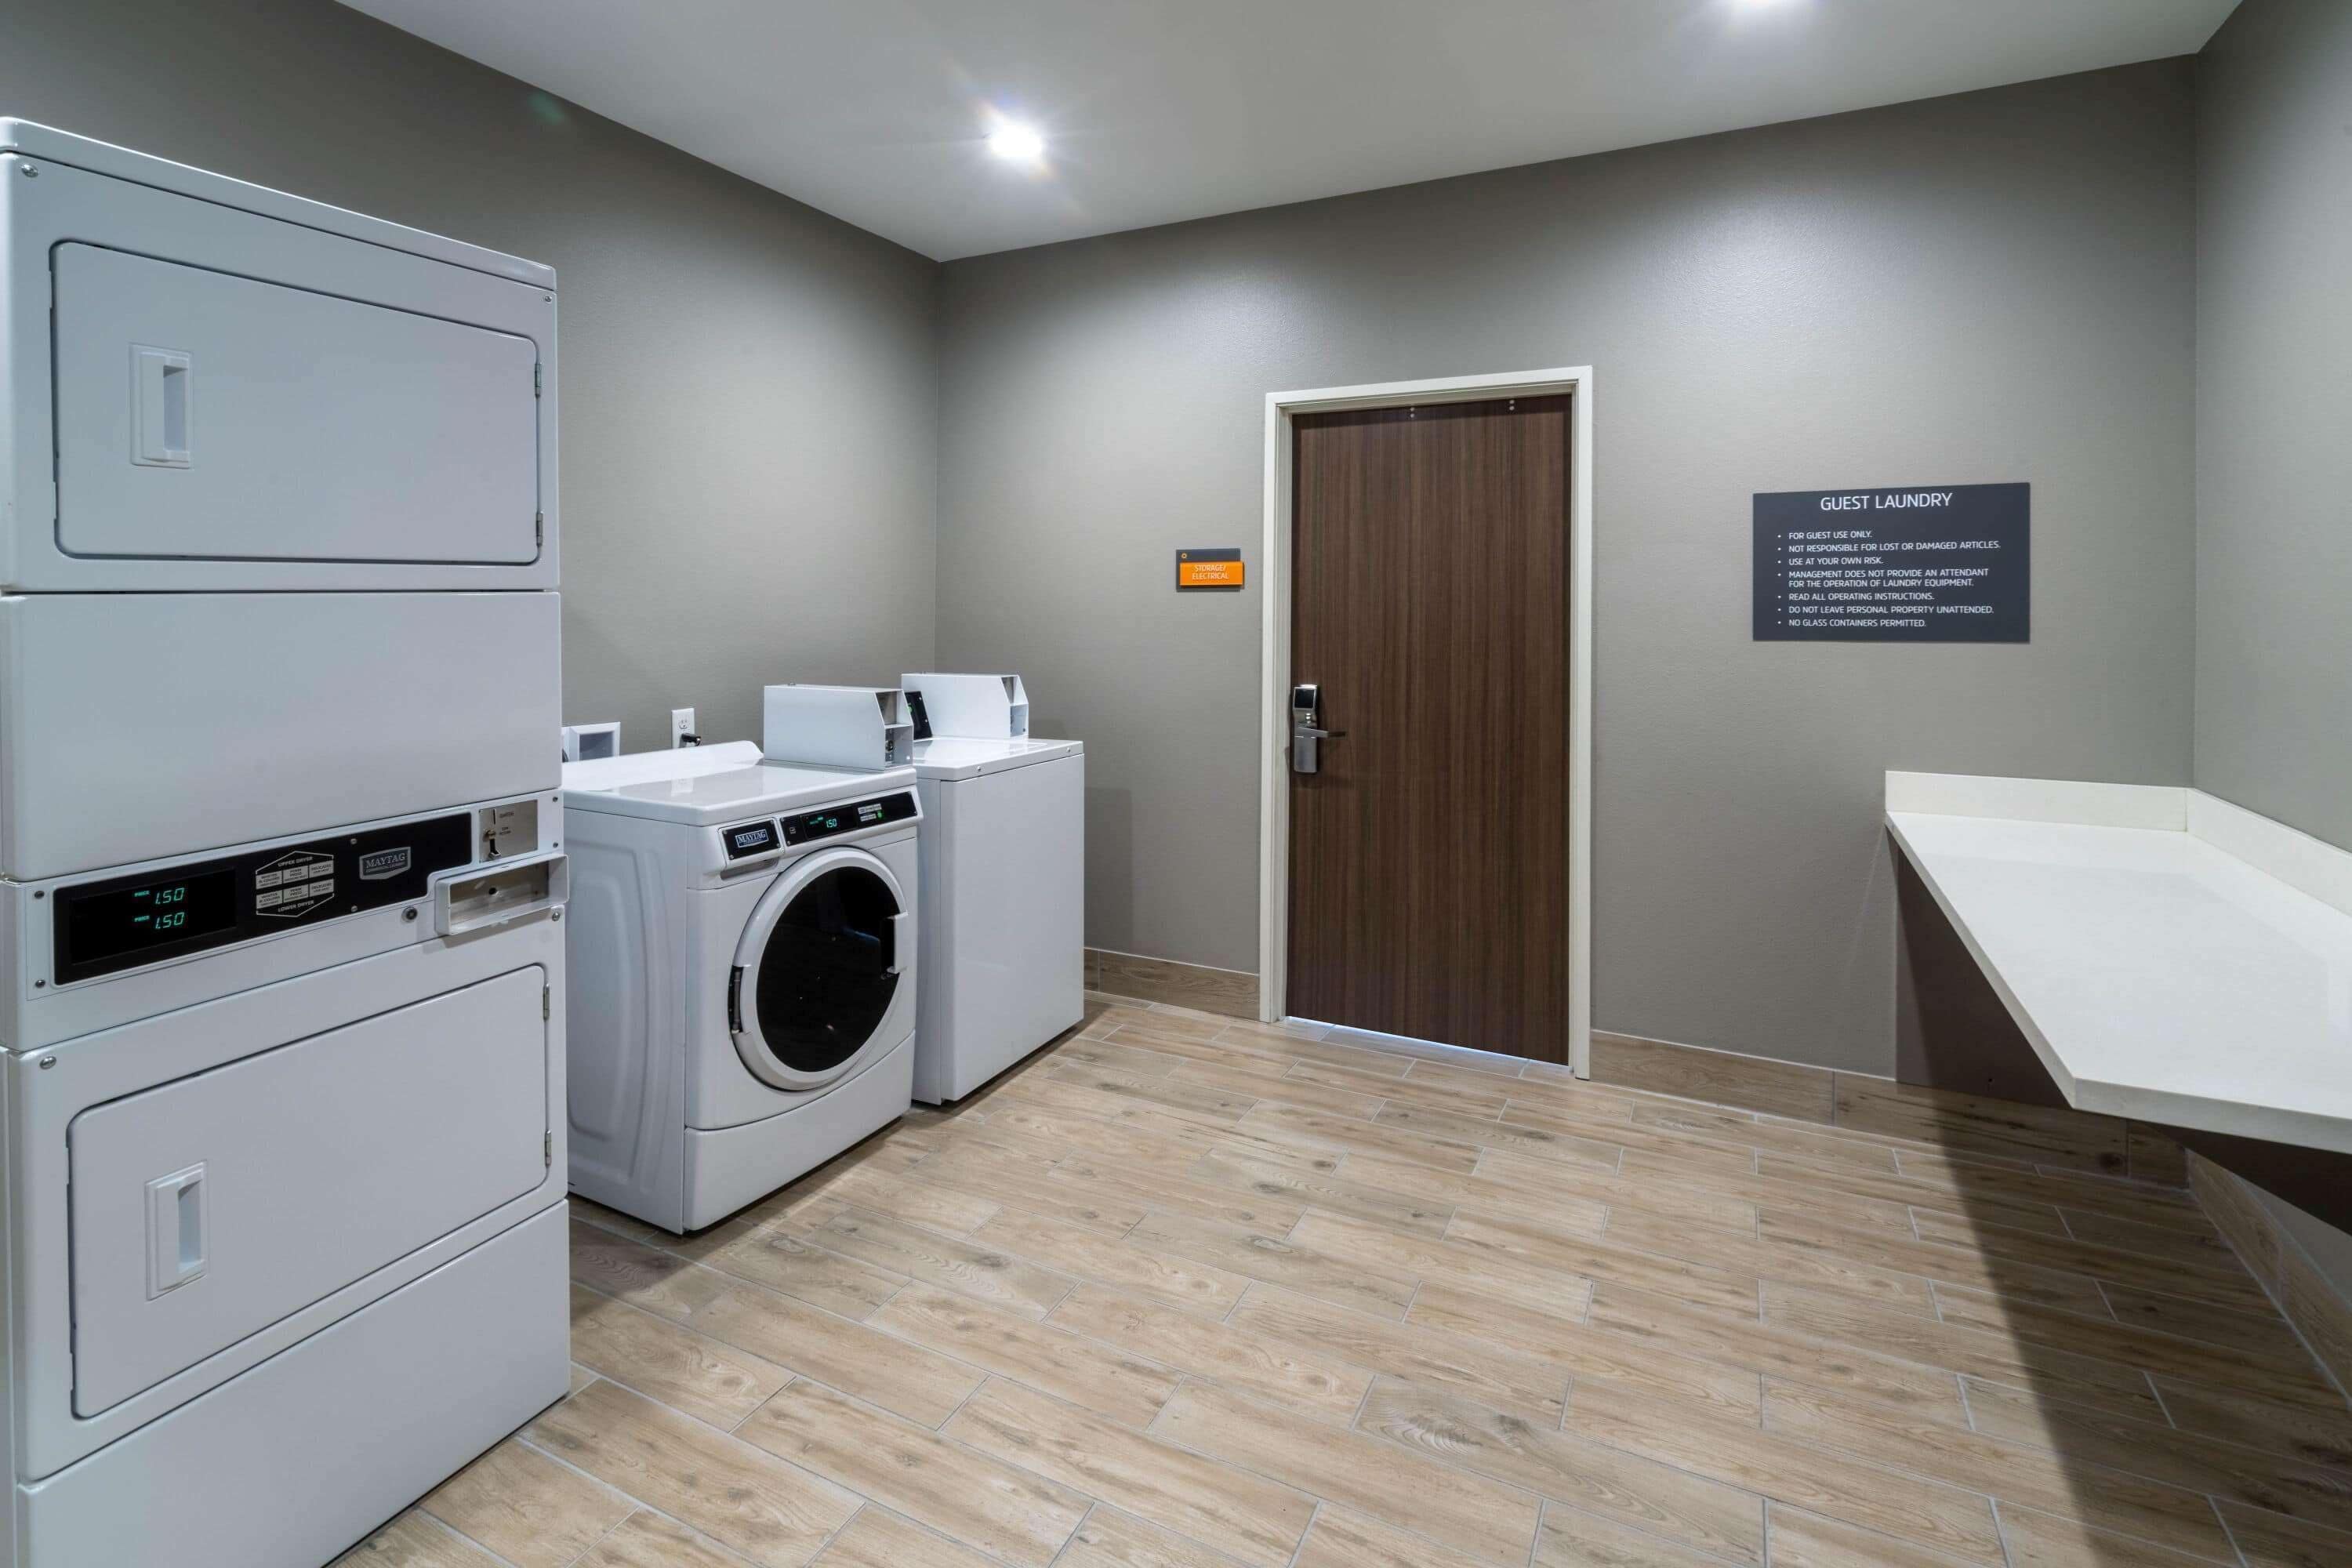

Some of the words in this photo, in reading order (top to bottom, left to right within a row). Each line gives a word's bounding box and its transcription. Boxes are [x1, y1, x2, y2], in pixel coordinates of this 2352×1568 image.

[1820, 495, 1870, 510] GUEST
[1875, 492, 1953, 509] LAUNDRY
[1883, 579, 1922, 587] LAUNDRY
[1925, 579, 1974, 587] EQUIPMENT.
[738, 832, 766, 844] MAYTAG
[365, 853, 405, 869] MAYTAG
[155, 887, 185, 904] 1.50
[278, 904, 296, 913] LOWER
[155, 912, 185, 928] 1.50
